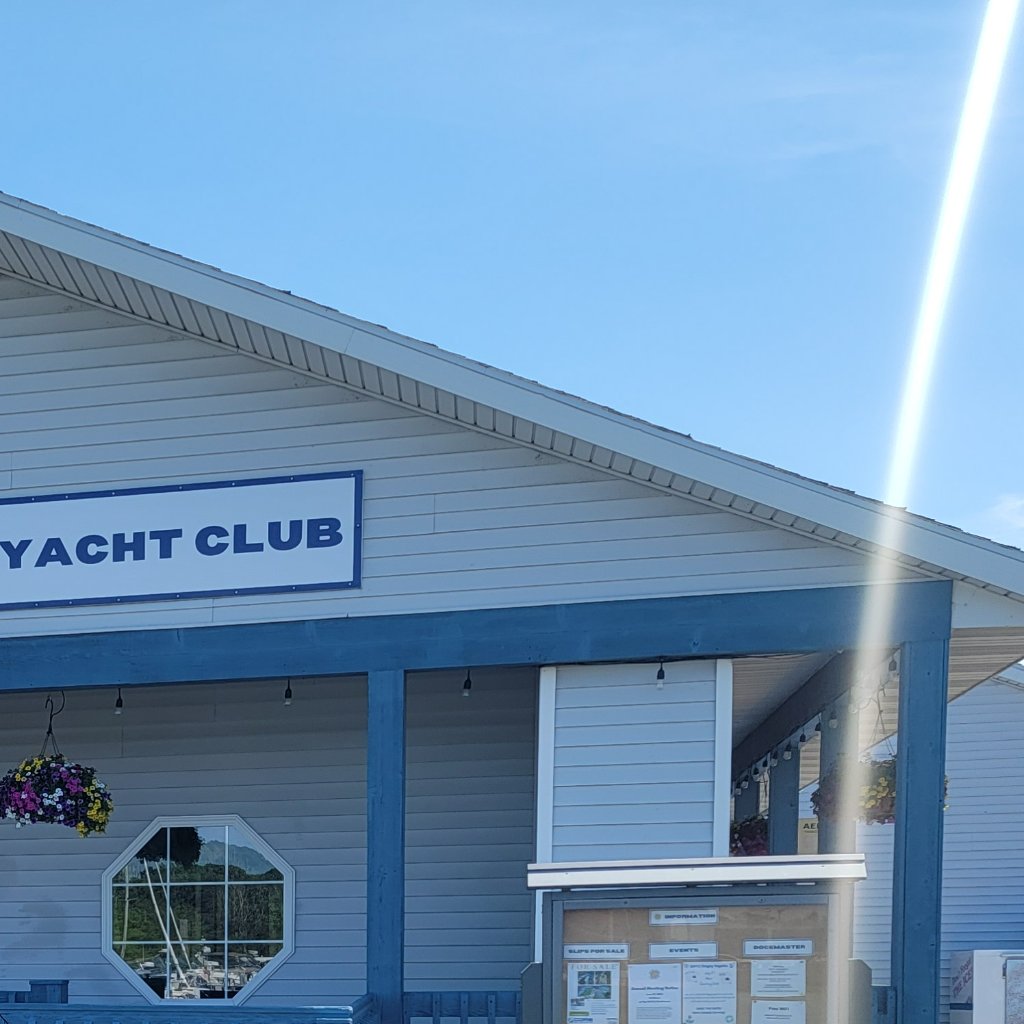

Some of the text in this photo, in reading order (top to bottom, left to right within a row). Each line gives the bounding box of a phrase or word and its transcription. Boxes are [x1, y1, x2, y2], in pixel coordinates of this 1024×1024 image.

[0, 528, 183, 569] YACHT
[195, 517, 344, 557] CLUB
[664, 912, 716, 920] INFORMATION
[753, 943, 806, 951] DOCKMASTER
